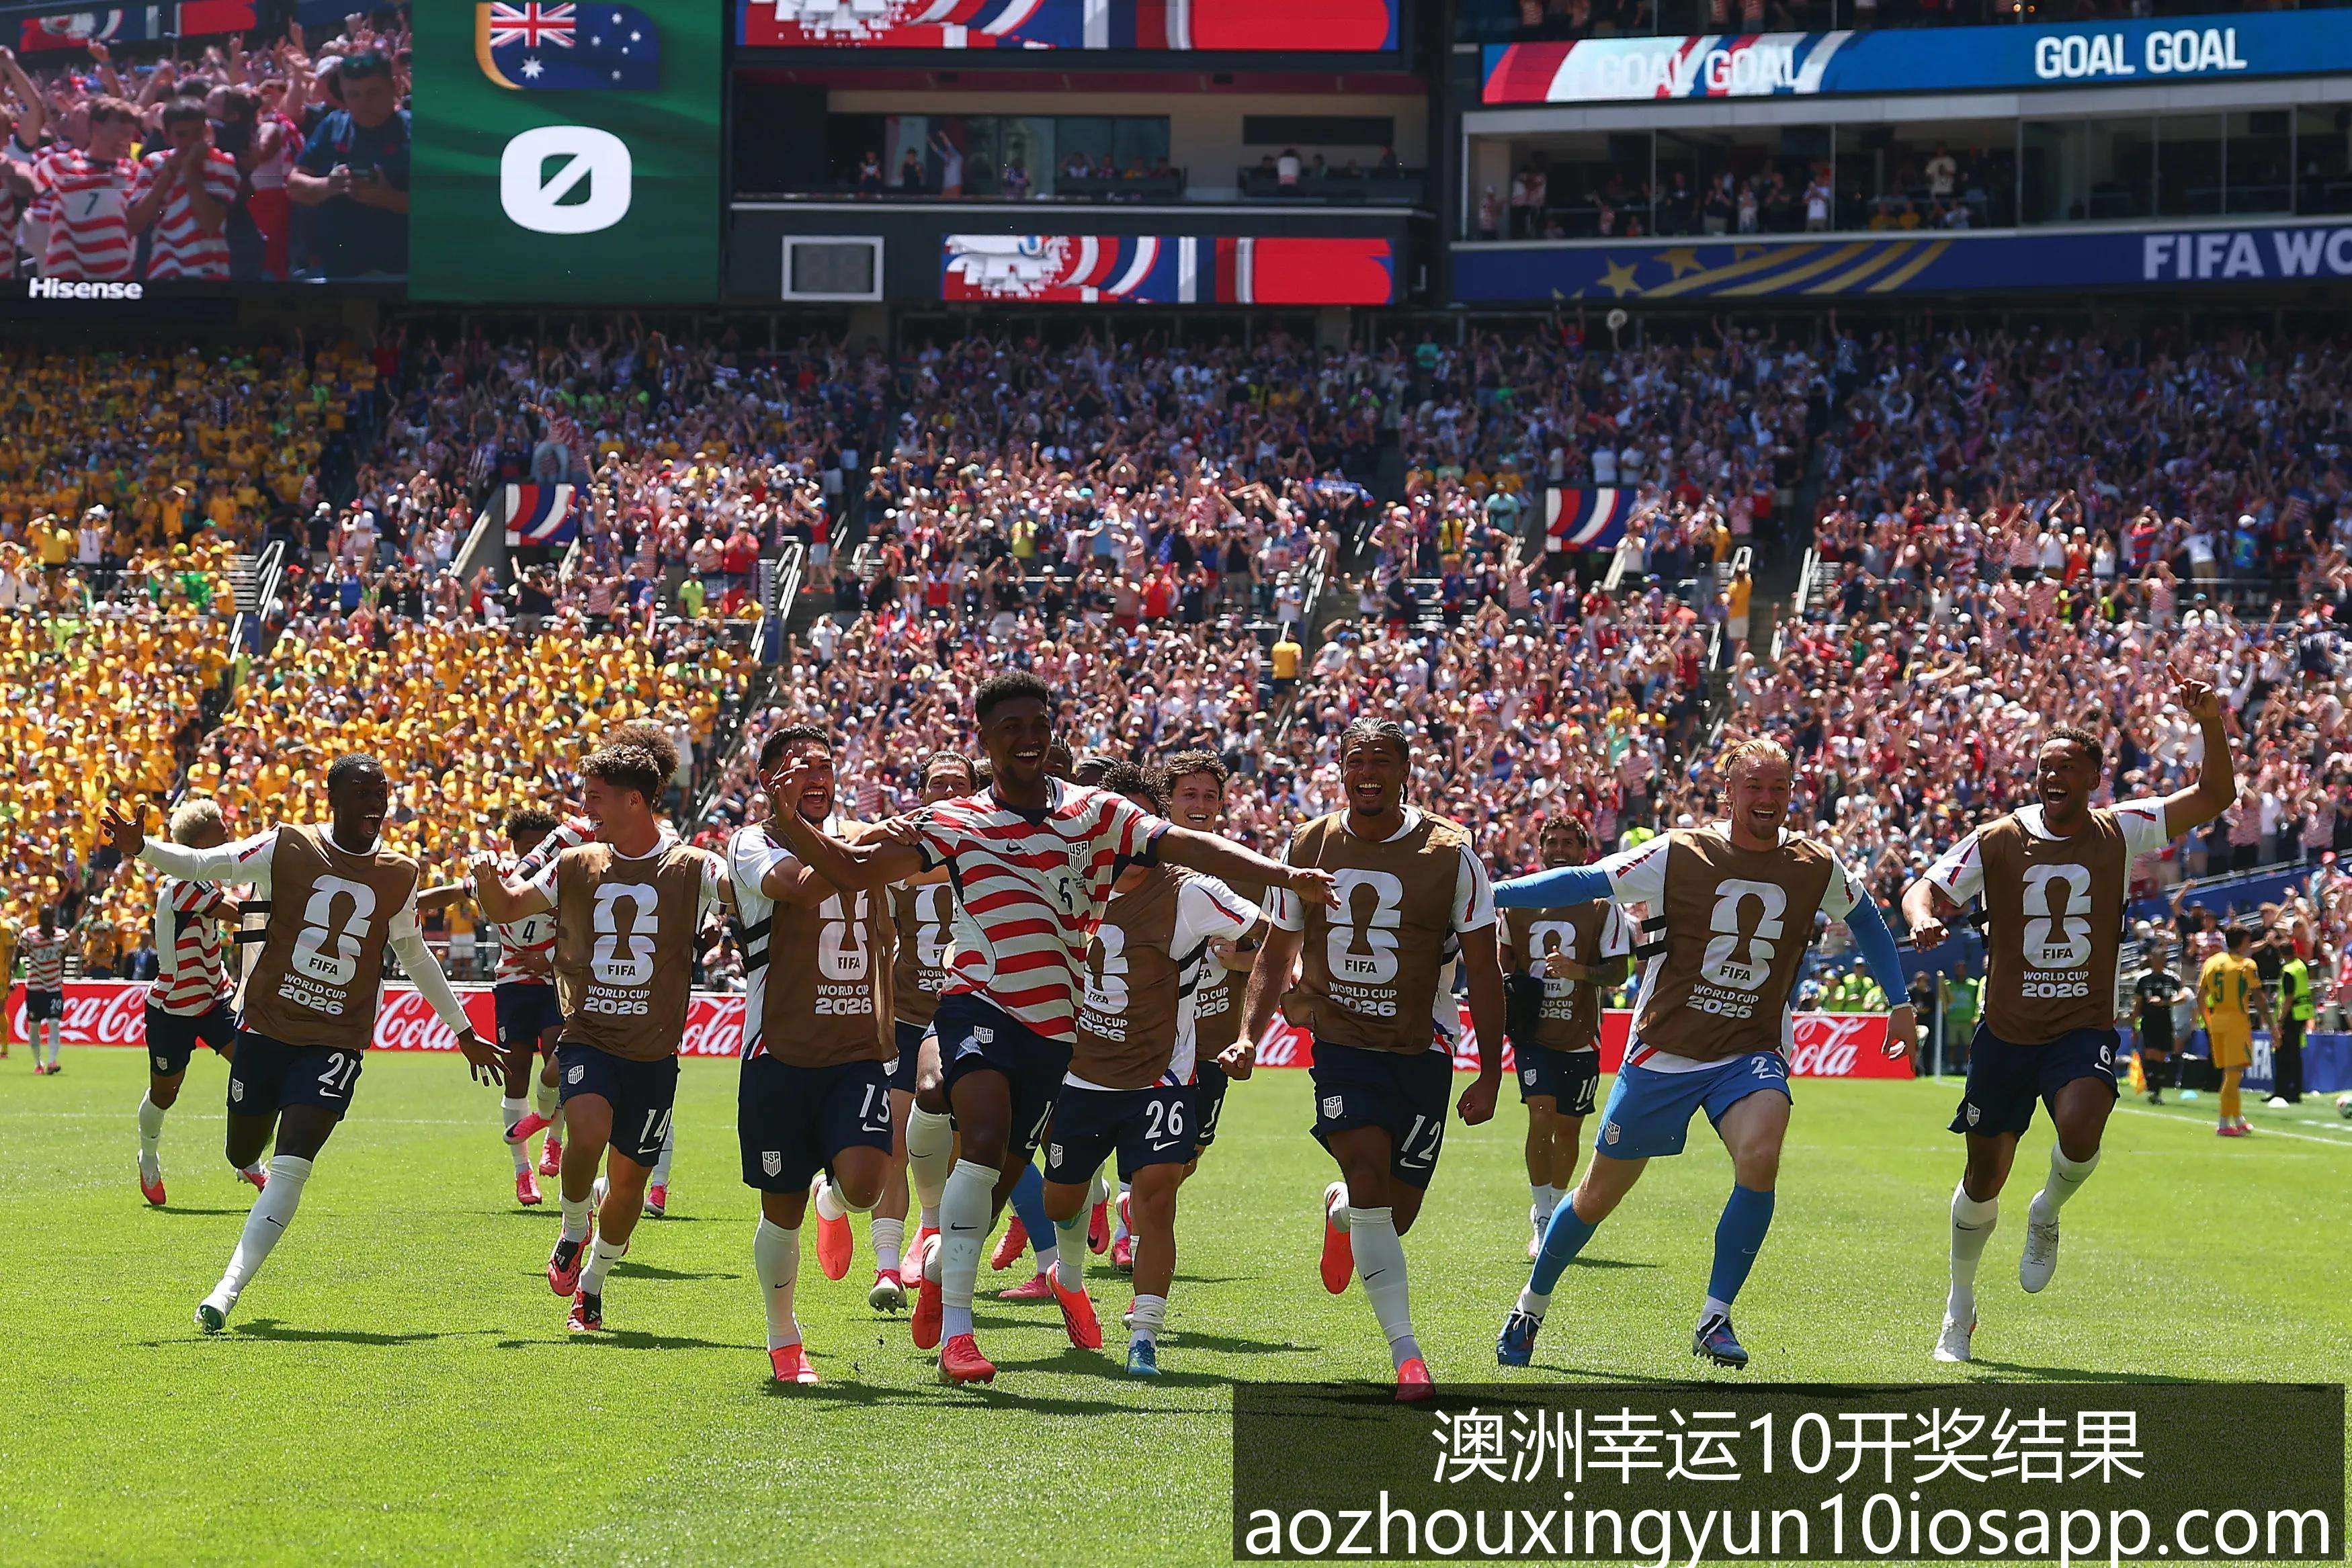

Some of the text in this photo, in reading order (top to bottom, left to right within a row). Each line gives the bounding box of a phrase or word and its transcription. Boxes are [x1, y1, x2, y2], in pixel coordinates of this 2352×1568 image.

[2035, 28, 2248, 79] GOAL GOAL
[1704, 45, 1800, 90] GOAL
[2144, 228, 2352, 280] FIFA WO
[28, 277, 143, 300] Hisense
[522, 920, 536, 943] 4
[837, 957, 860, 969] FIFA
[2043, 948, 2074, 959] FIFA
[309, 957, 338, 975] FIFA
[607, 965, 636, 975] FIFA
[917, 969, 946, 977] WOR
[1345, 959, 1378, 973] FIFA
[1720, 965, 1751, 981] FIFA
[918, 978, 945, 991] 20
[2023, 971, 2089, 981] WORLD CUP
[284, 973, 347, 1000] WORLD CUP
[588, 985, 650, 999] WORLD CUP
[817, 985, 869, 996] WORLD CUP
[1210, 986, 1229, 1000] CUP
[1329, 982, 1397, 999] WORLD CUP
[1693, 984, 1759, 1004] WORLD CUP
[2022, 982, 2089, 998] 2026
[278, 984, 343, 1015] 2026
[583, 996, 648, 1015] 2026
[815, 998, 872, 1015] 2026
[1194, 998, 1230, 1019] 026
[1556, 1000, 1574, 1008] CUP
[1685, 995, 1753, 1019] 2026
[1081, 1007, 1128, 1028] ORLD CUP
[1539, 1007, 1572, 1020] 026
[1079, 1016, 1126, 1042] 026
[2100, 1045, 2111, 1065] 6
[318, 1052, 357, 1090] 21
[1577, 1076, 1597, 1103] 10
[640, 1107, 671, 1143] 14
[1145, 1100, 1183, 1139] 26
[1401, 1115, 1441, 1161] 12
